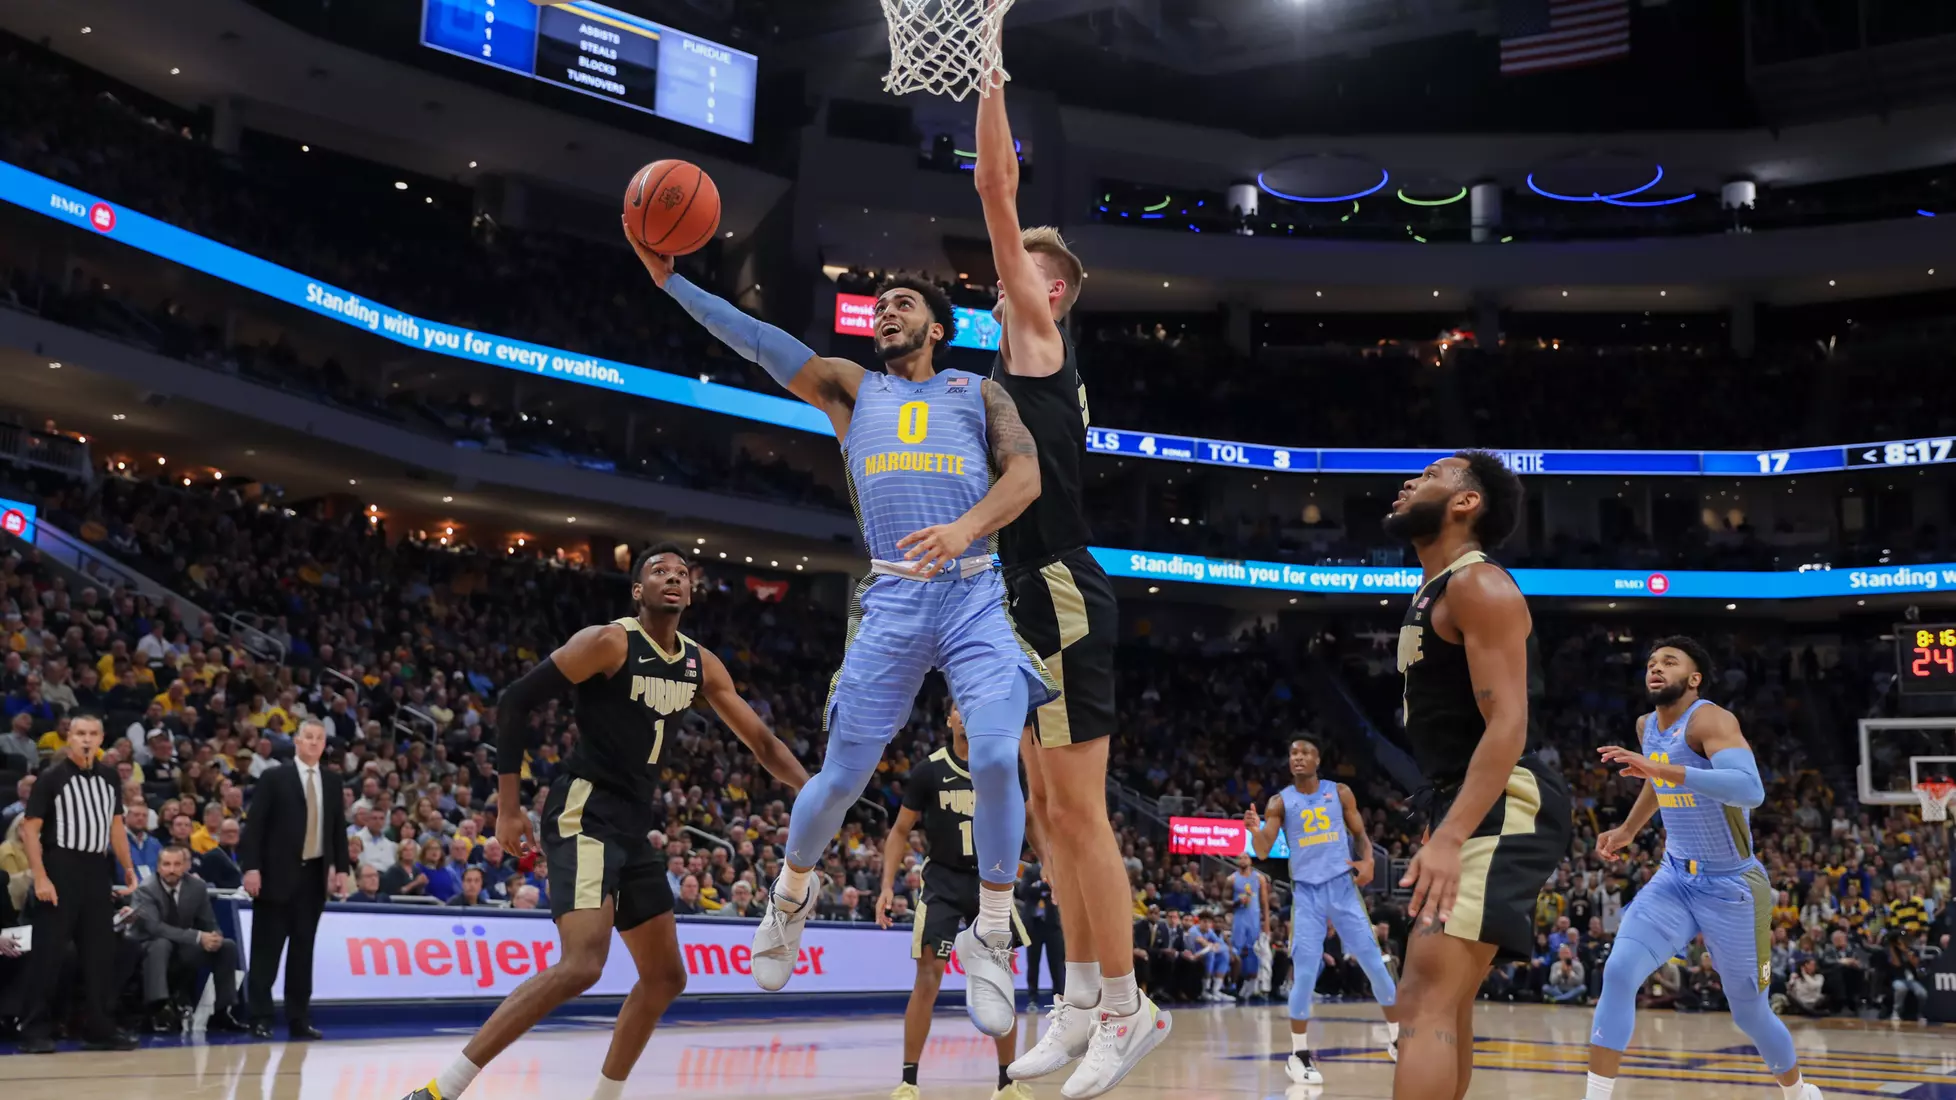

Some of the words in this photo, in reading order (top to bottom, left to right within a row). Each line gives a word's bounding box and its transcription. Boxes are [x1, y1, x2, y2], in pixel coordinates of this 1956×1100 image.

[579, 23, 620, 45] ASSISTS
[579, 40, 617, 60] STEALS
[682, 39, 732, 65] PURDUE
[578, 56, 617, 76] BLOCKS
[567, 68, 626, 95] TURNOVERS
[50, 193, 86, 217] BMO
[306, 282, 380, 330] Standing
[383, 314, 419, 340] with
[423, 327, 459, 349] you
[463, 332, 492, 356] for
[495, 344, 549, 373] every
[552, 356, 625, 385] ovation.
[897, 401, 929, 444] 0
[865, 452, 965, 477] MARQUETTE
[1138, 436, 1157, 456] 4
[1208, 443, 1250, 464] TOL
[1273, 450, 1291, 469] 3
[1497, 453, 1544, 472] UETTE
[1756, 452, 1790, 473] 17
[1884, 439, 1953, 465] 8:17
[1130, 554, 1205, 580] Standing
[1208, 560, 1246, 580] with
[1249, 566, 1280, 585] you
[1283, 566, 1306, 584] for
[1310, 573, 1359, 591] every
[1614, 579, 1644, 590] BMO
[1849, 567, 1937, 589] Standing
[1916, 629, 1956, 648] 8:16
[1912, 648, 1954, 676] 24
[629, 674, 698, 716] PURDUE
[647, 719, 665, 764] 1
[939, 789, 976, 817] PUR
[1300, 807, 1331, 833] 25
[959, 820, 973, 856] 1
[346, 925, 554, 988] meijer
[684, 943, 828, 976] meer
